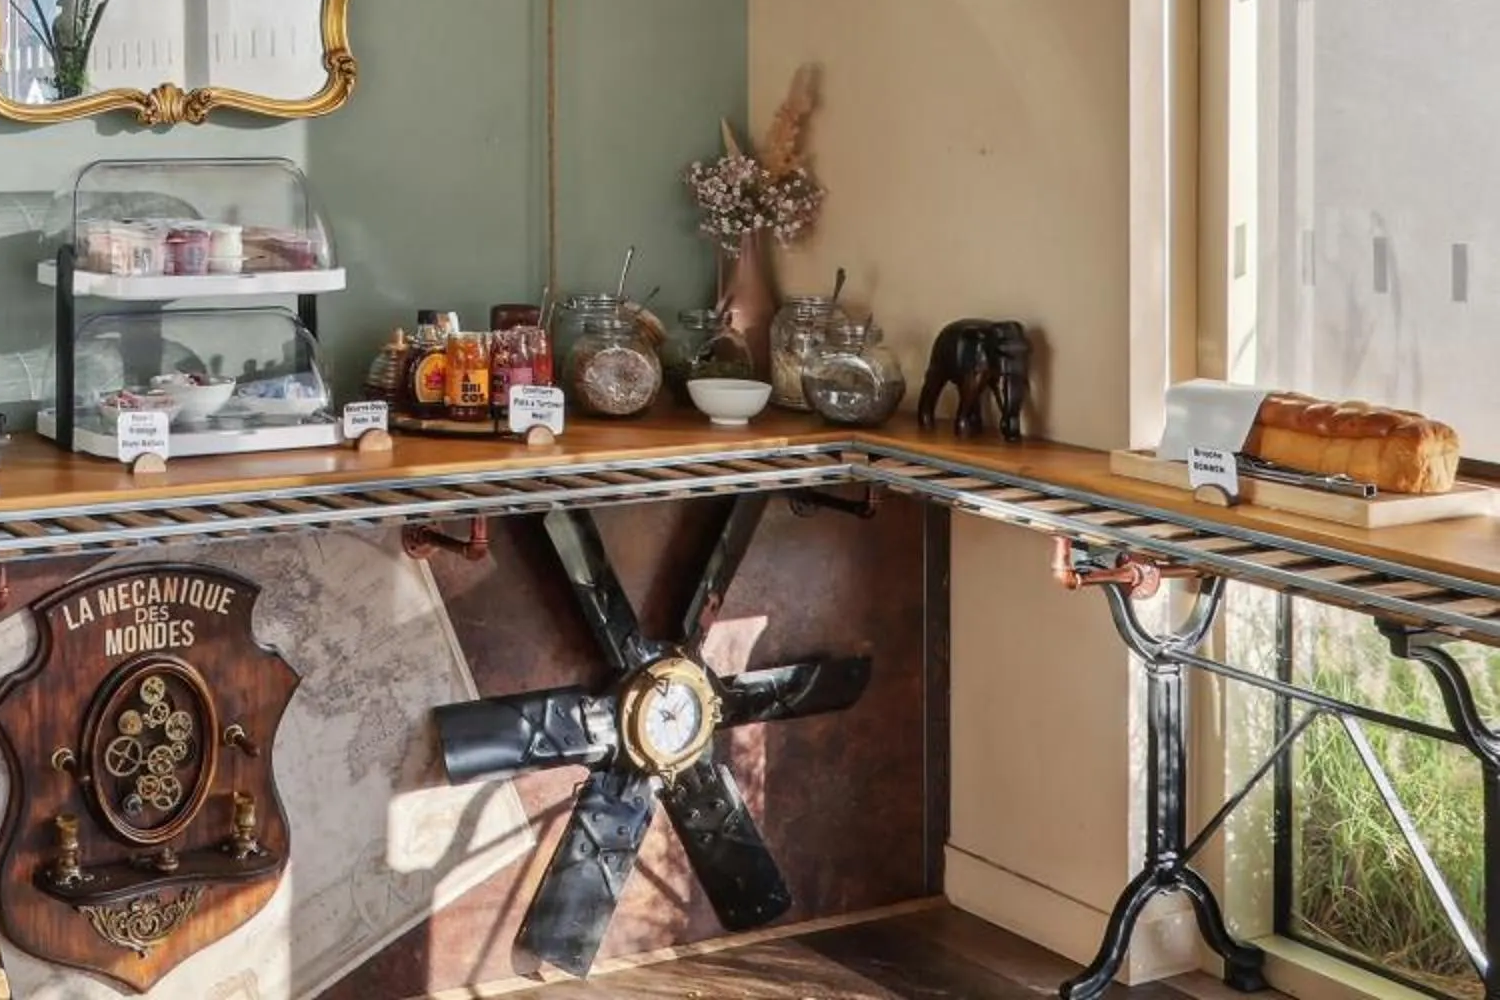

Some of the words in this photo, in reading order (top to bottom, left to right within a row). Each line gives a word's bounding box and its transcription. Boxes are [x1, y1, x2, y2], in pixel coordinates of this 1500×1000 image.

[62, 596, 95, 631] LA
[98, 576, 237, 617] MECANIQUE
[135, 605, 170, 624] DES
[105, 619, 196, 657] MONDES
